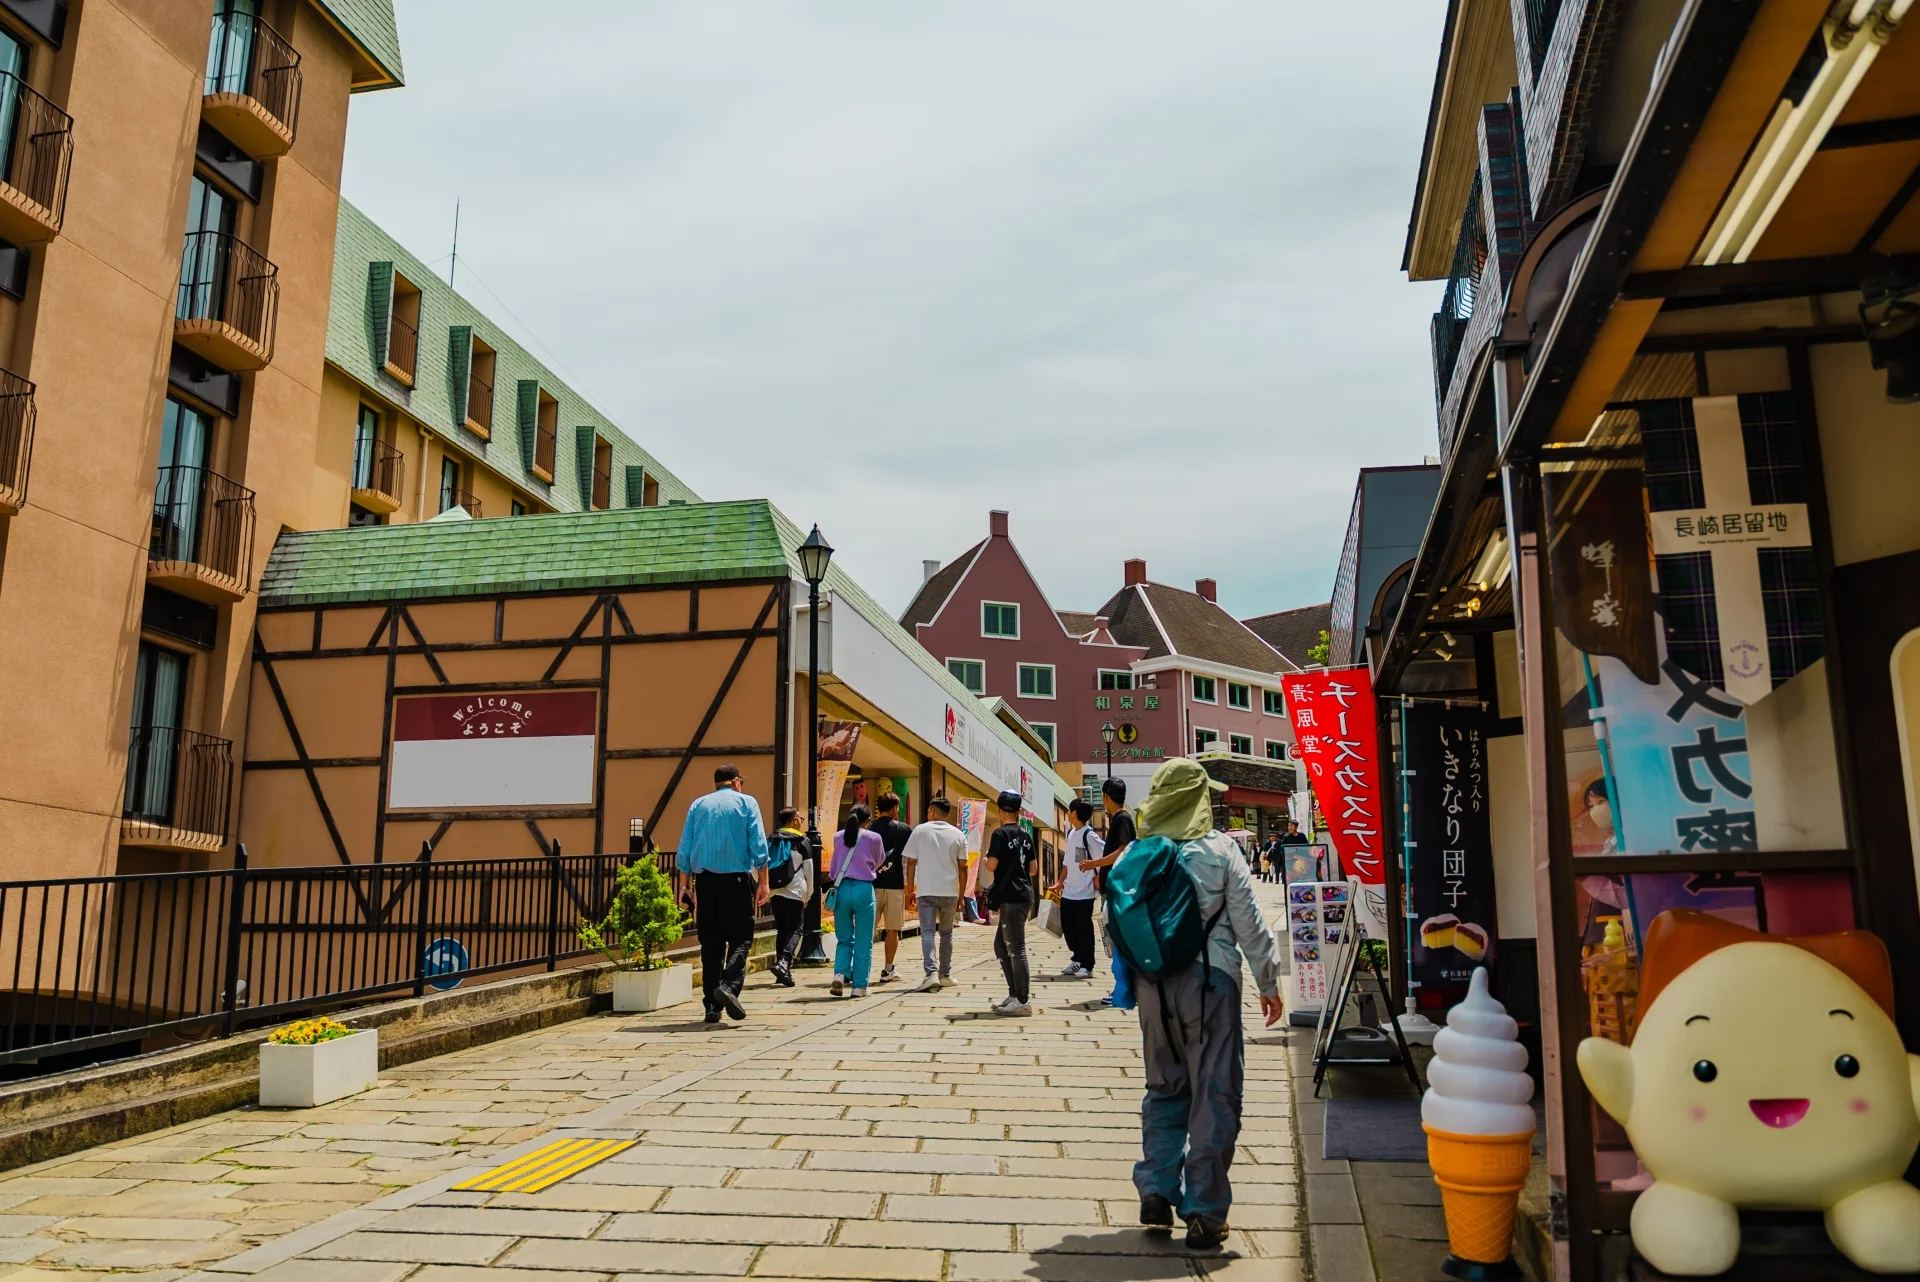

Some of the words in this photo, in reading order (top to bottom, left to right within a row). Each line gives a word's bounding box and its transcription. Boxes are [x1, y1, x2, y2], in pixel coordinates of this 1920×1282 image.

[1674, 511, 1788, 538] 長崎居留地
[452, 697, 533, 722] Welcome
[1095, 695, 1160, 710] 和泉屋
[462, 722, 522, 735] ようこそ
[1091, 746, 1165, 759] オランダ物産館
[1468, 729, 1483, 813] はちみつ入り
[1439, 724, 1468, 909] いきなり団子
[1297, 963, 1308, 1003] ありません。
[1307, 963, 1317, 999] 駅・空港に
[1317, 963, 1326, 1000] 当店の商品は
